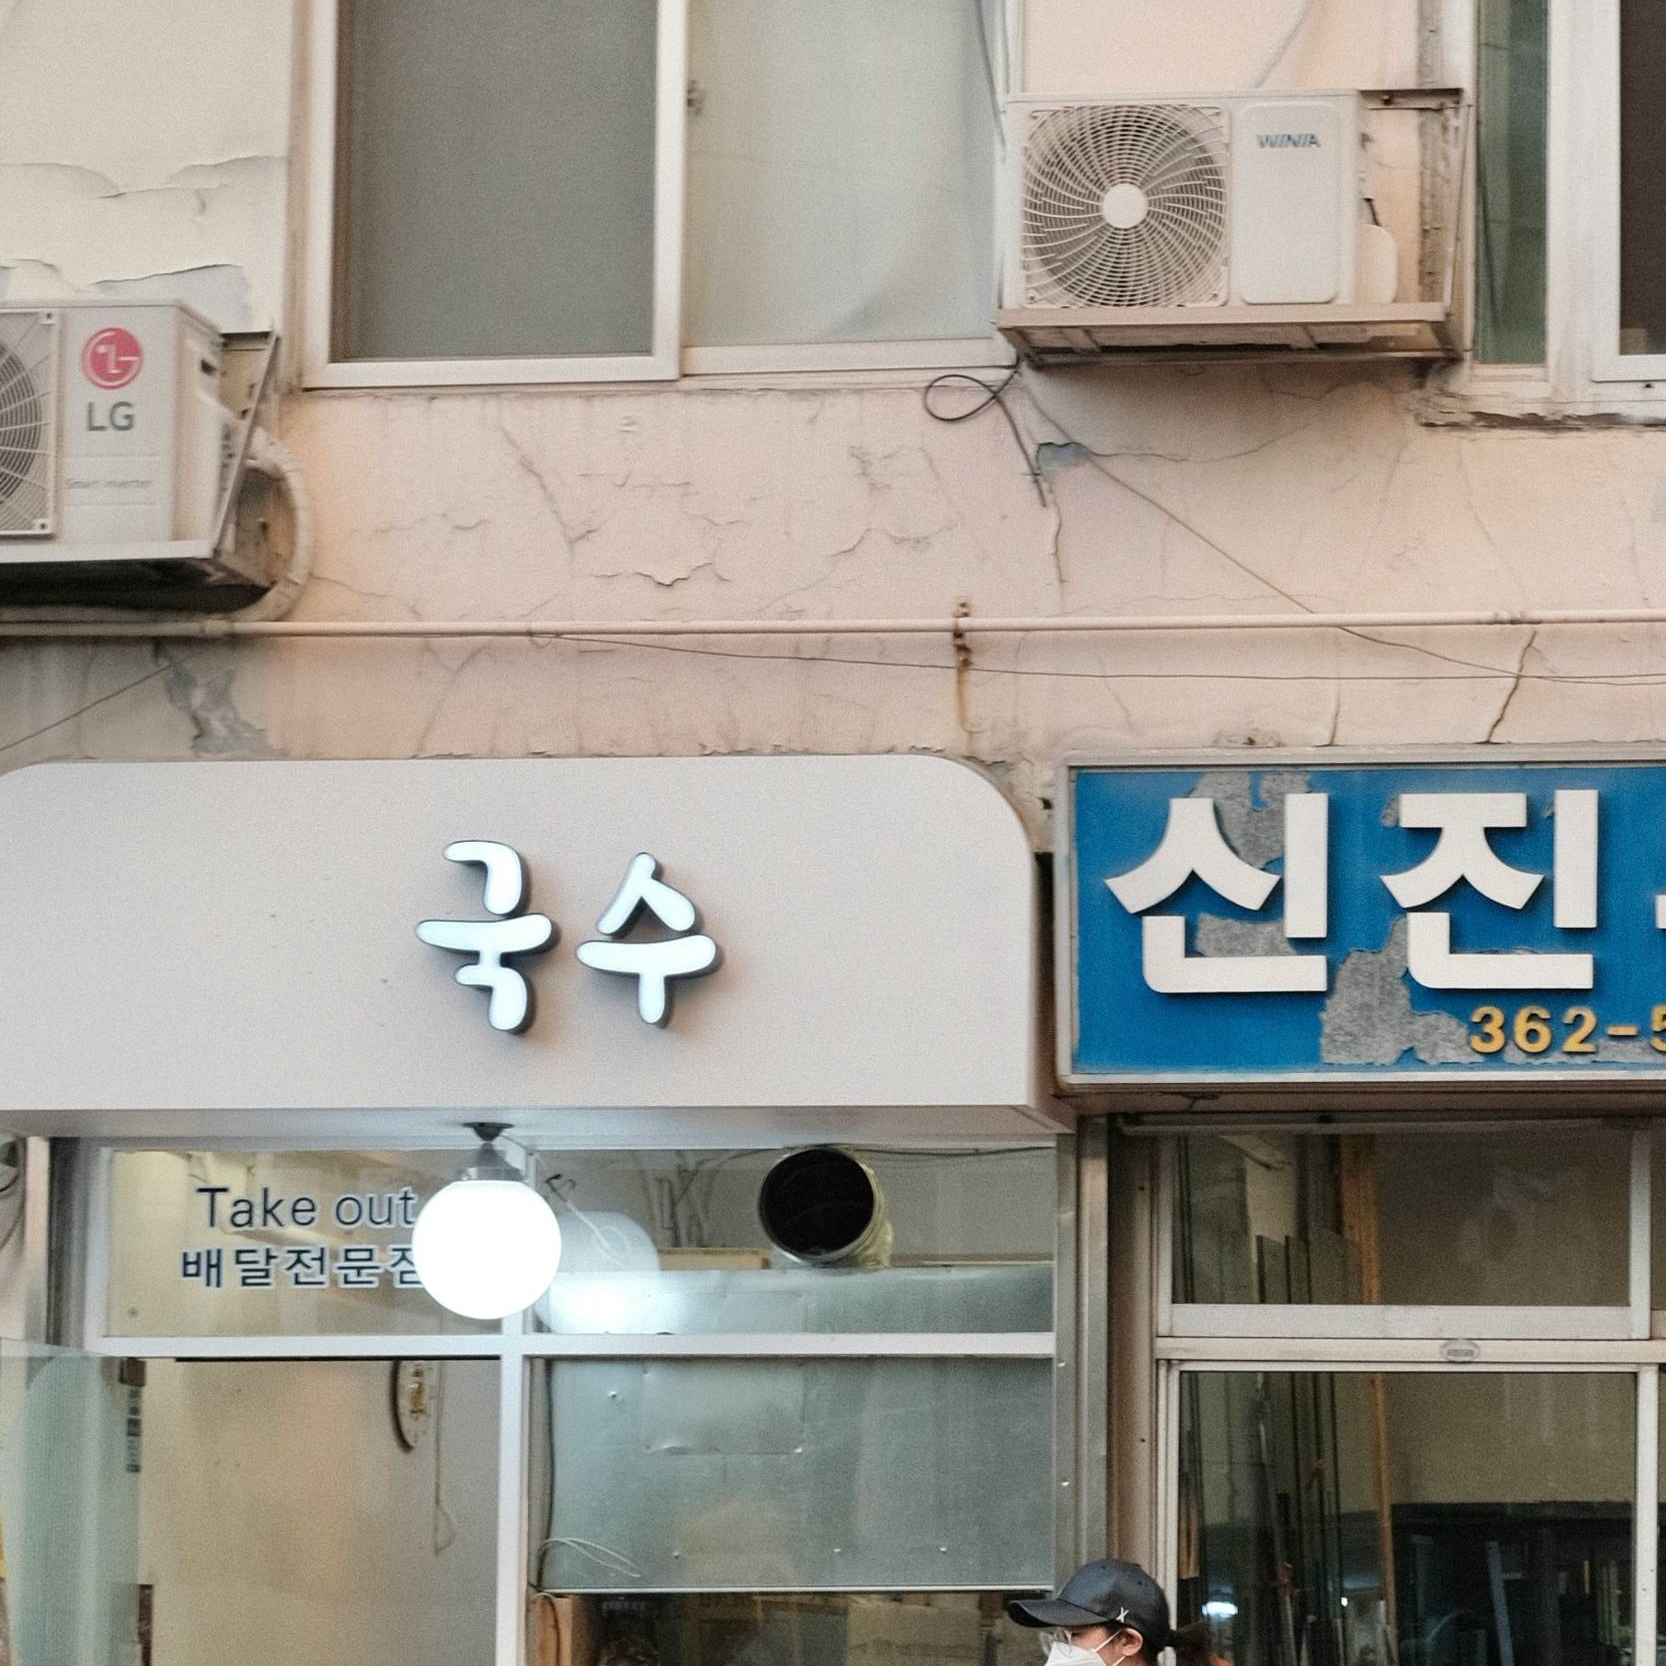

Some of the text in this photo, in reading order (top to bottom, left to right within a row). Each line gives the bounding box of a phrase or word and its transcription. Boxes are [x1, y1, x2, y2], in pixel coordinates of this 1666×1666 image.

[86, 401, 135, 431] LG
[415, 839, 722, 1035] 국수
[195, 1186, 416, 1229] Take out
